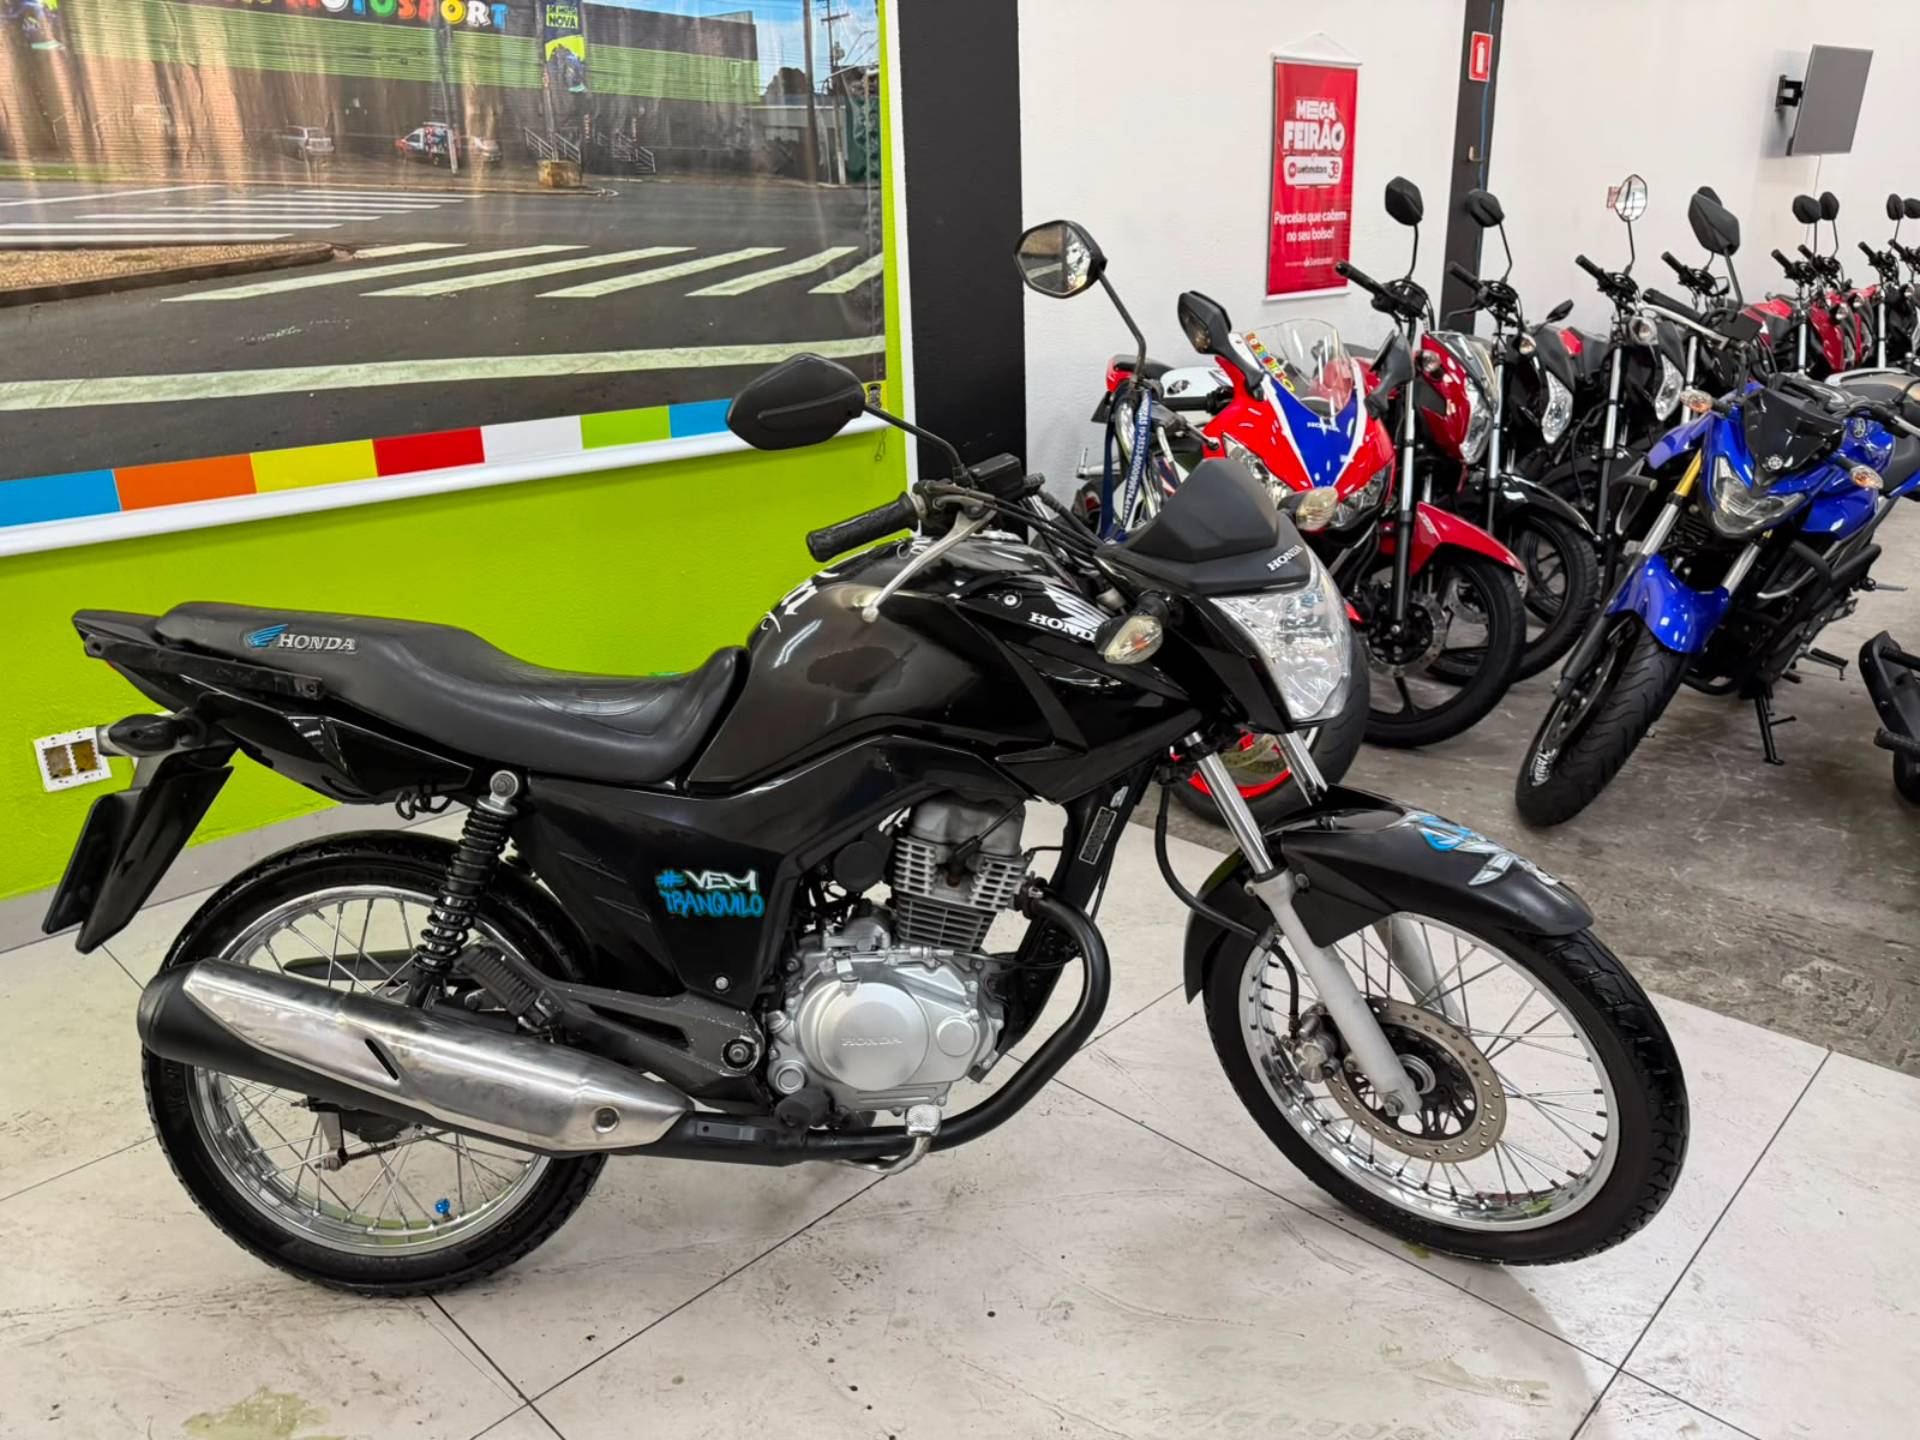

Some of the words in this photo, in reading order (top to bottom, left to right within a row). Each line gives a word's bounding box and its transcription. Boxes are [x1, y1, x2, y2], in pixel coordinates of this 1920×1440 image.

[285, 0, 508, 29] TOSPORT
[547, 15, 578, 28] NOVA
[1296, 99, 1337, 120] MEGA
[1283, 118, 1345, 151] FEIRÃO
[1274, 211, 1306, 225] Parcelas
[1307, 212, 1321, 226] que
[1322, 208, 1347, 222] cabem
[1286, 231, 1297, 242] no
[1297, 231, 1310, 242] seu
[1311, 226, 1335, 240] bolso!
[1266, 544, 1304, 572] HONDA
[1028, 611, 1096, 643] HOND
[277, 633, 356, 651] HONDA
[659, 889, 765, 919] TRANQUILO
